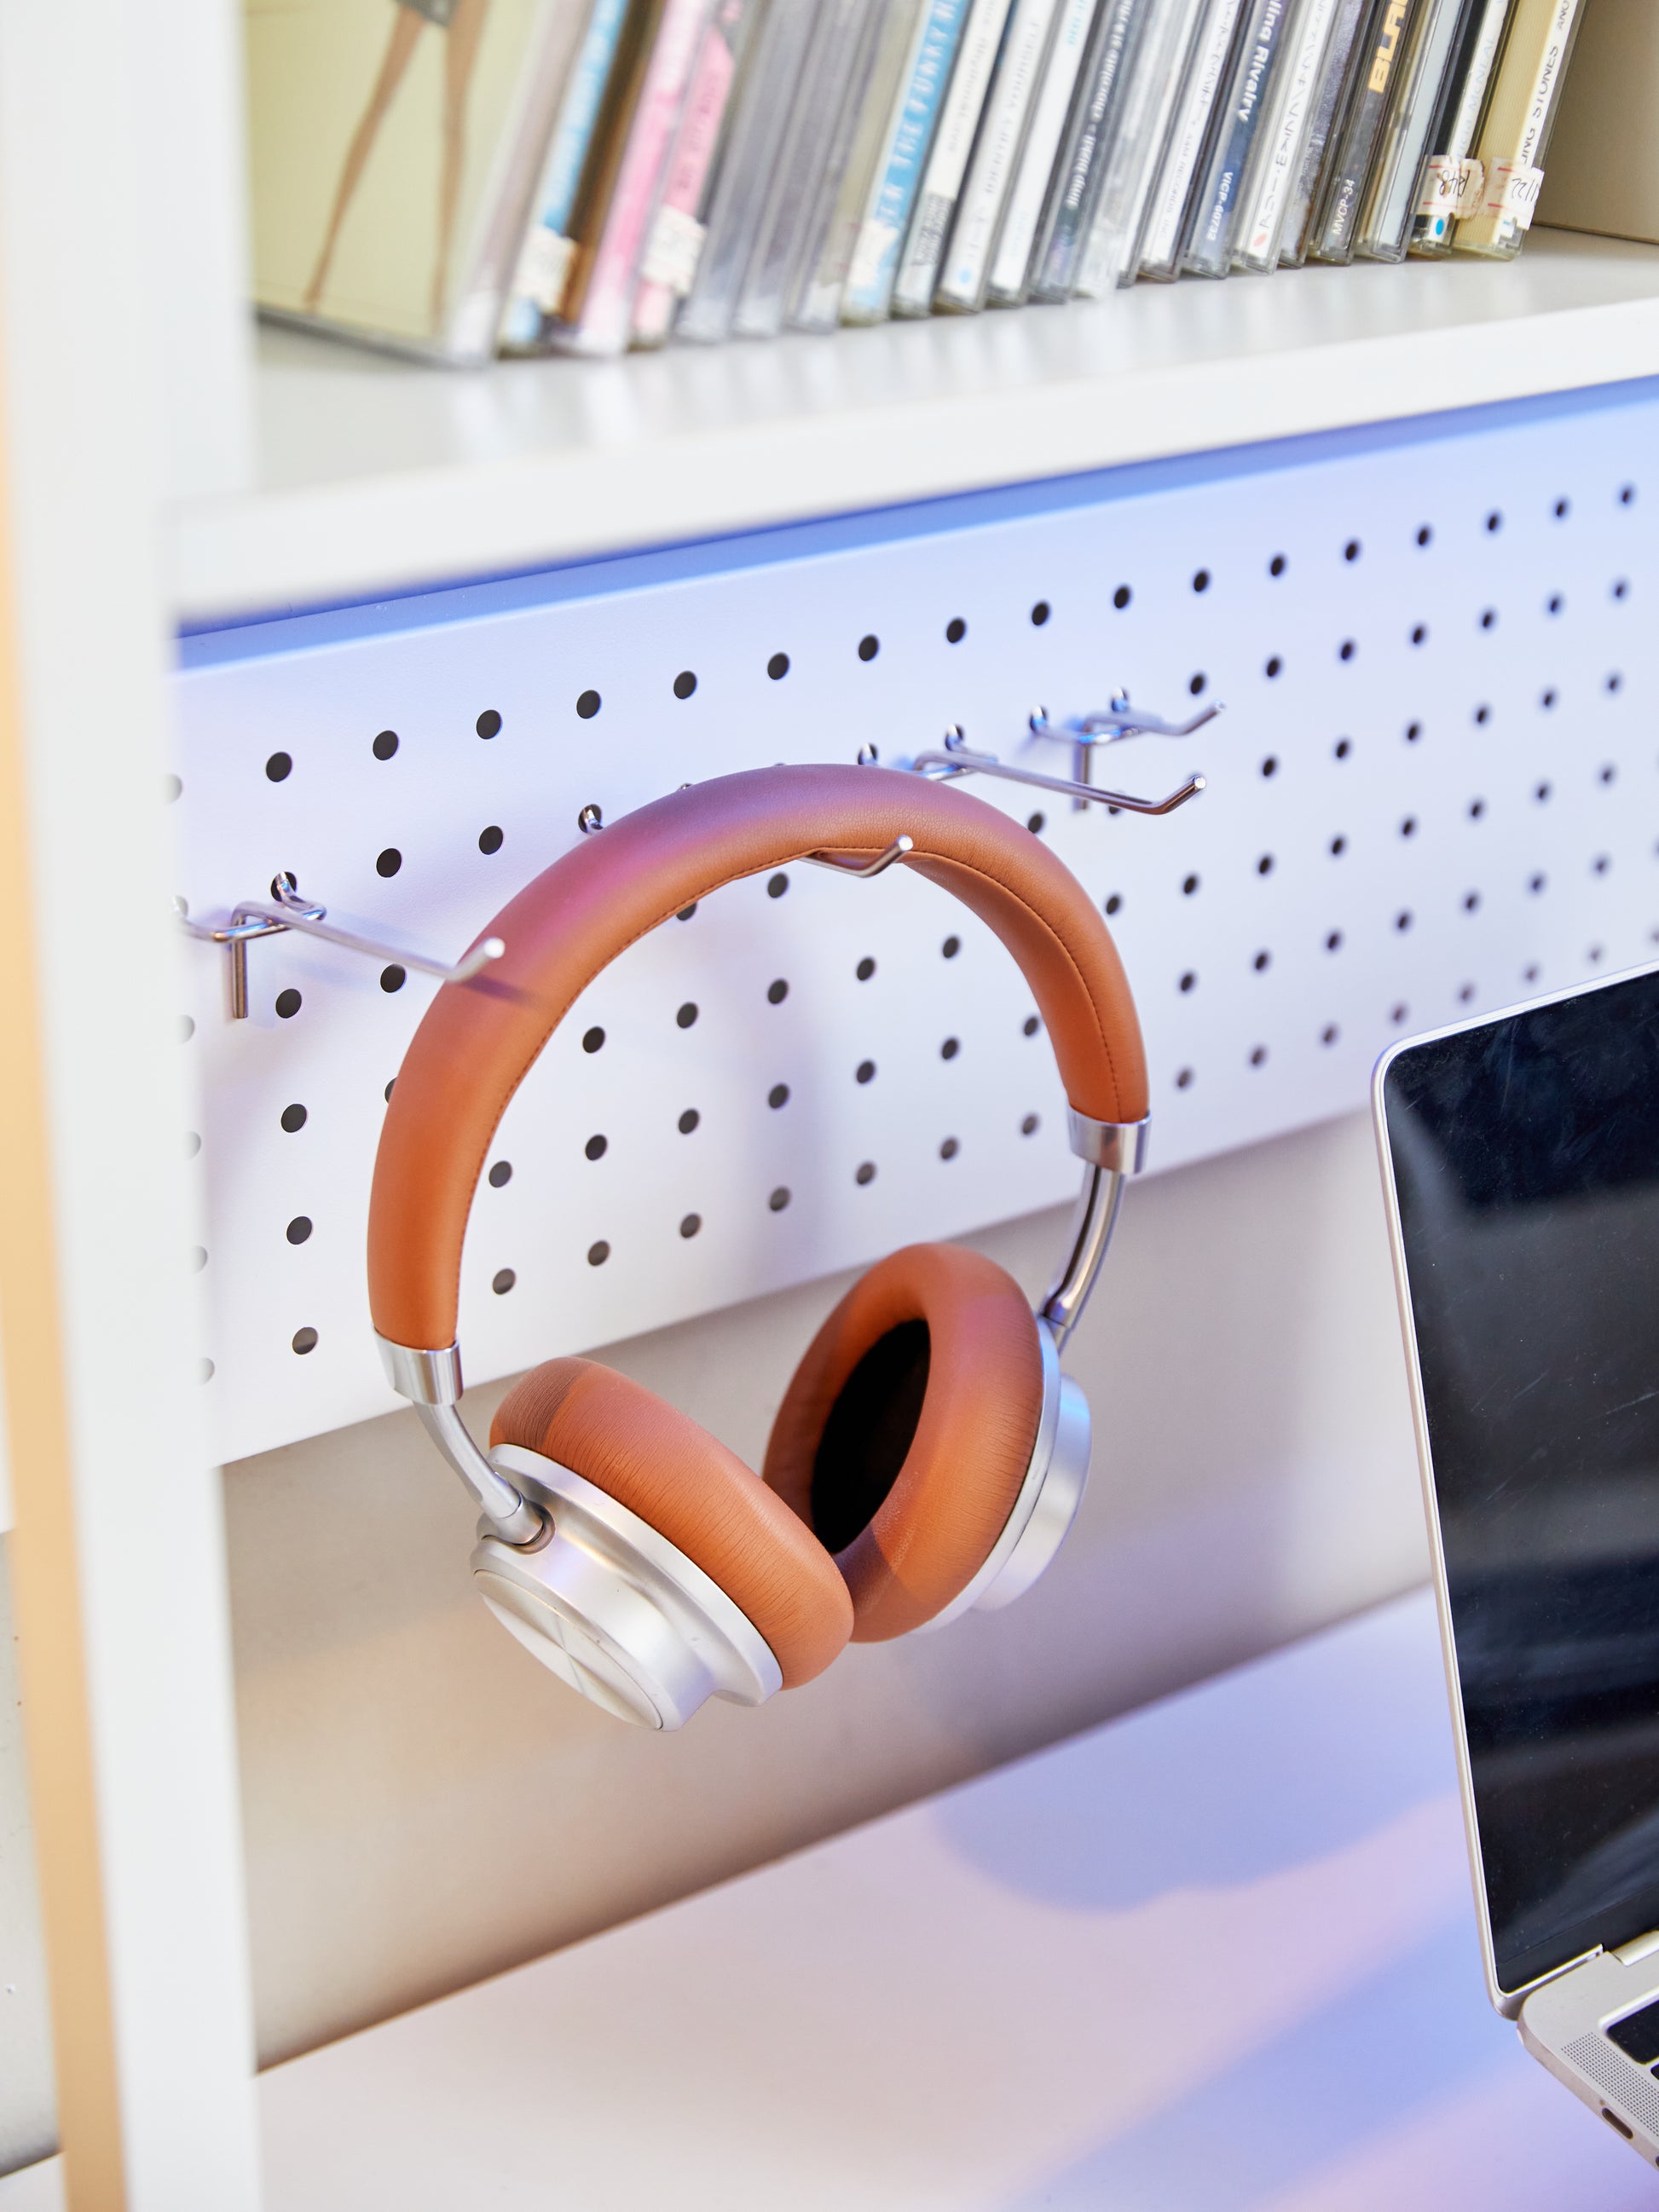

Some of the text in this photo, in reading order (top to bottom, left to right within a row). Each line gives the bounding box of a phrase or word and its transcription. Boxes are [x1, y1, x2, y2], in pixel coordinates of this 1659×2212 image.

[1238, 45, 1270, 122] Rivalry
[1367, 0, 1408, 94] BLA
[1205, 171, 1234, 241] VICP-60732
[1332, 178, 1356, 235] MVCP-34
